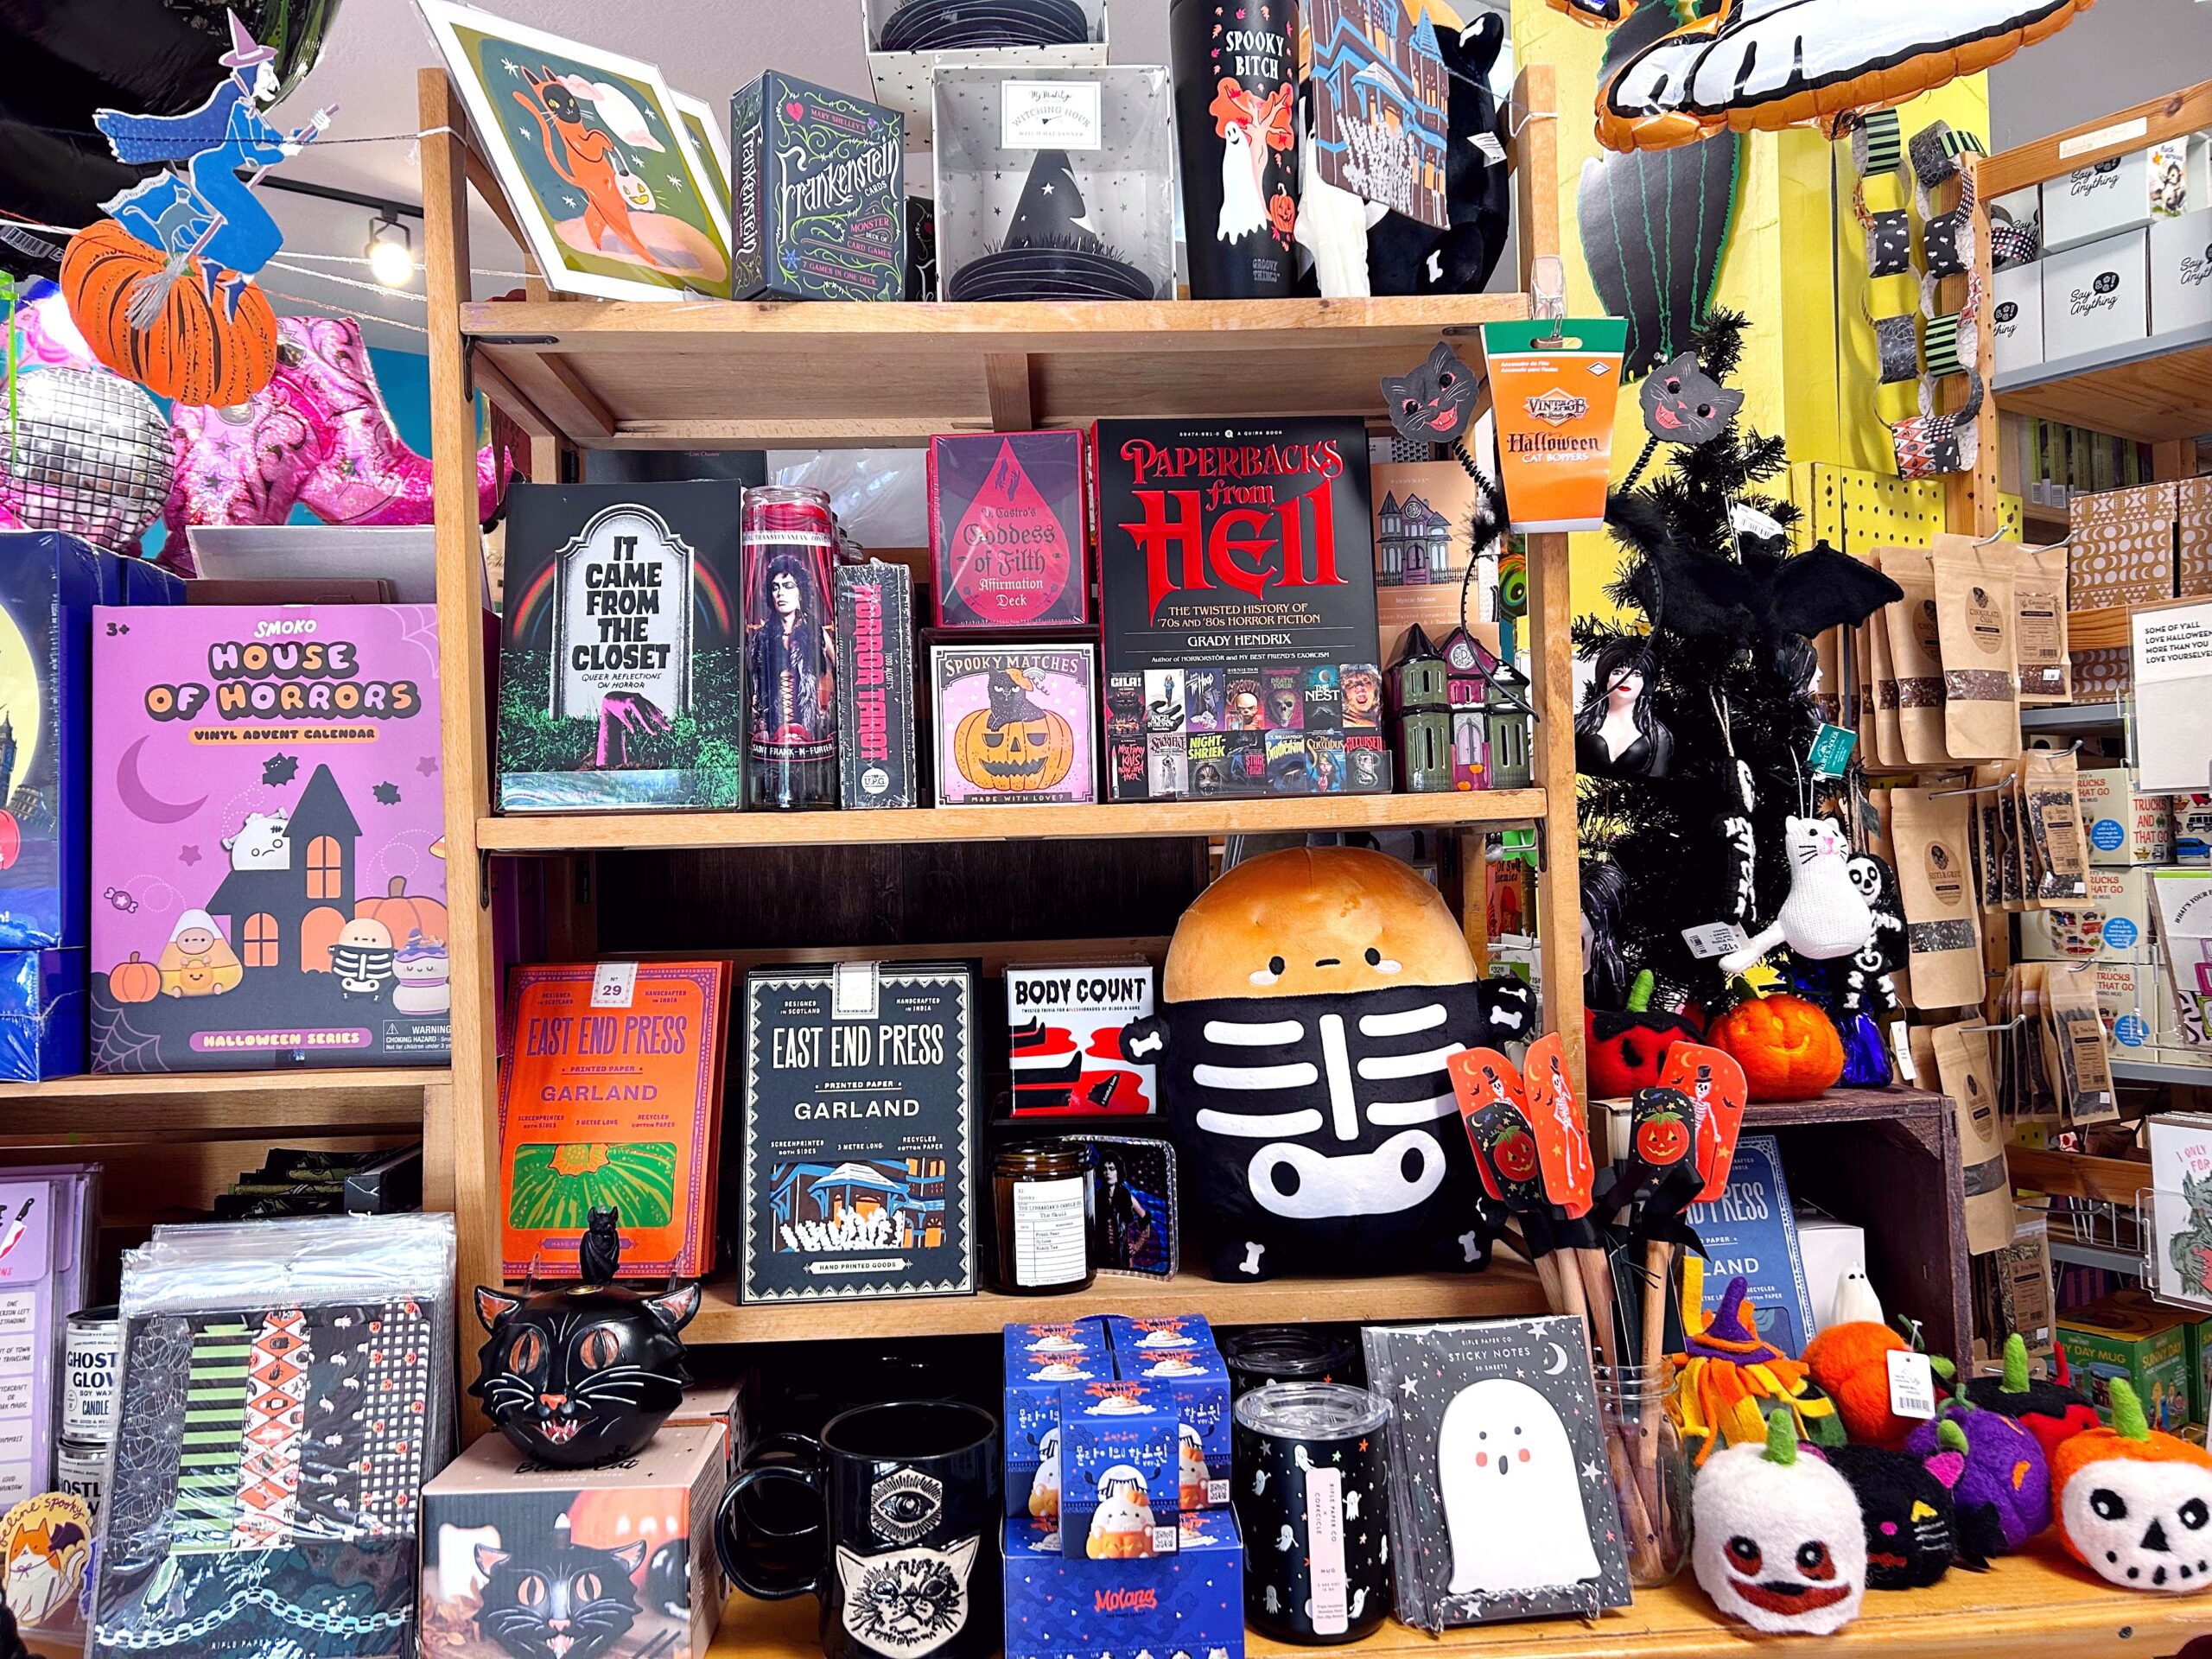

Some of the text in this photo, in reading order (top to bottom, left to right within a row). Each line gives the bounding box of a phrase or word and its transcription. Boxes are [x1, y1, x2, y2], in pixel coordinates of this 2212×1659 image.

[1225, 29, 1284, 57] SPOOKY
[1236, 57, 1279, 79] BITCH
[810, 107, 866, 131] MARY SHELLEY'S
[1012, 106, 1090, 128] WITCHING HOUR
[775, 137, 899, 243] Frankenstein
[864, 181, 887, 197] CARDS
[2071, 175, 2120, 196] Anything
[850, 218, 889, 232] MONSTER
[848, 240, 892, 257] CARD GAMES
[1252, 259, 1277, 271] GROOVY
[2180, 257, 2204, 272] Say
[809, 263, 875, 285] GAMES IN ONE DECK
[2071, 289, 2092, 302] Say
[2071, 294, 2119, 315] Anything
[1528, 398, 1586, 413] VINTAGE
[1507, 432, 1604, 453] Halloween
[1121, 439, 1344, 484] PAPERBACKS
[1522, 453, 1588, 462] CAT BOPPERS
[1205, 480, 1274, 512] from
[995, 507, 1036, 518] Castro's
[963, 524, 1055, 546] Goddess
[613, 537, 638, 562] IT
[975, 550, 1046, 576] of Filth
[585, 563, 662, 588] CAME
[979, 578, 1043, 592] Affirmation
[586, 590, 659, 615] FROM
[996, 594, 1027, 607] Deck
[1168, 603, 1308, 616] THE TWISTED HISTORY OF
[106, 622, 130, 636] 3+
[1182, 614, 1320, 627] AND HORROR FICTION
[253, 620, 317, 639] SMOKO
[597, 618, 648, 642] THE
[1187, 634, 1291, 647] GRADY HENDRIX
[211, 643, 353, 674] HOUSE
[572, 644, 671, 671] CLOSET
[852, 585, 888, 761] HORROR TAROT
[945, 656, 1078, 677] SPOOKY MATCHES
[885, 666, 893, 690] ALCOTT'S
[1111, 677, 1141, 687] GILA!
[146, 683, 416, 716] OF HORRORS
[1305, 690, 1339, 702] NEST
[194, 729, 375, 741] VINYL ADVENT CALENDAR
[1190, 735, 1226, 748] NIGHT-
[753, 743, 832, 757] SAINT FRANK-N-FURTER
[1188, 746, 1225, 760] SHRIEK
[2133, 798, 2166, 810] TRUCKS
[2138, 815, 2154, 828] AND
[2133, 830, 2156, 843] THAT
[2158, 831, 2169, 842] GO
[2175, 891, 2208, 924] WHAT'S YOUR
[603, 986, 621, 995] 29
[1015, 978, 1146, 1005] BODY COUNT
[2098, 982, 2119, 990] THAT
[412, 1026, 451, 1034] WARNING
[526, 1015, 687, 1056] EAST END PRESS
[203, 1033, 359, 1047] HALLOWEEN SERIES
[772, 1024, 944, 1069] EAST END PRESS
[541, 1085, 658, 1101] GARLAND
[794, 1099, 919, 1120] GARLAND
[2184, 1145, 2206, 1158] ONLY
[2191, 1159, 2210, 1173] FOR
[1448, 1346, 1531, 1362] STICKY NOTES
[2075, 1346, 2126, 1363] DAY MUG
[2142, 1349, 2167, 1369] SUNNY
[82, 1400, 109, 1414] CANDLE
[1076, 1443, 1167, 1466] 몰랑이의 할로윈
[44, 1497, 85, 1520] spooky
[1094, 1589, 1158, 1613] Molang
